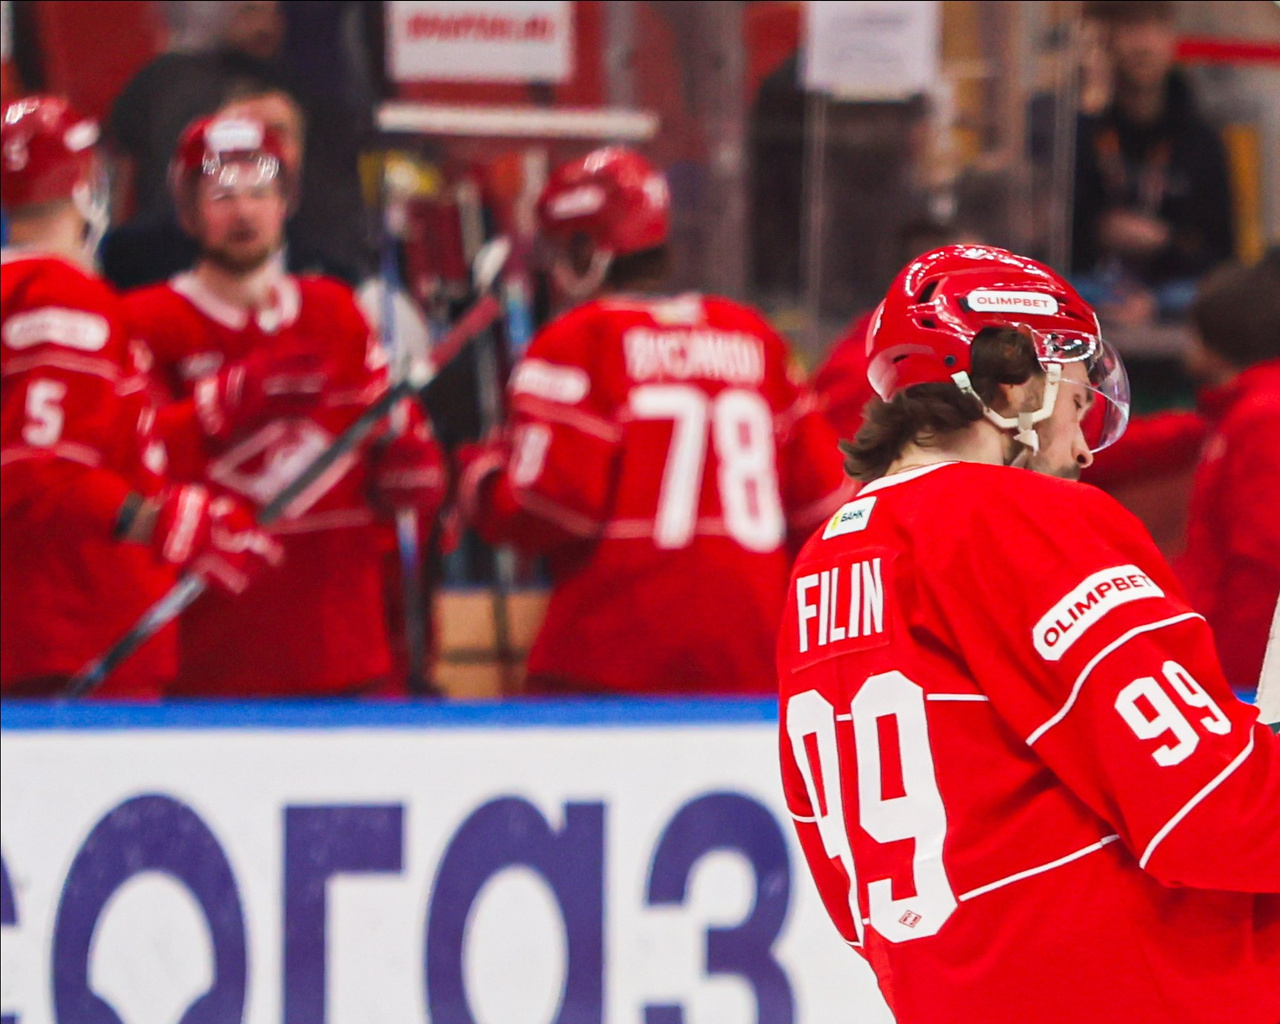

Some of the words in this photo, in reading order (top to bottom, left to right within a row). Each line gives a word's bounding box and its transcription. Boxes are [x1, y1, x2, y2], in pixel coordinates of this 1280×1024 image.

[976, 296, 1049, 308] OLIMPBET
[22, 378, 67, 446] 5
[628, 384, 786, 552] 78
[796, 558, 885, 653] FILIN
[1043, 574, 1152, 647] OLIMPBET
[1114, 660, 1232, 767] 99
[786, 670, 958, 948] 99
